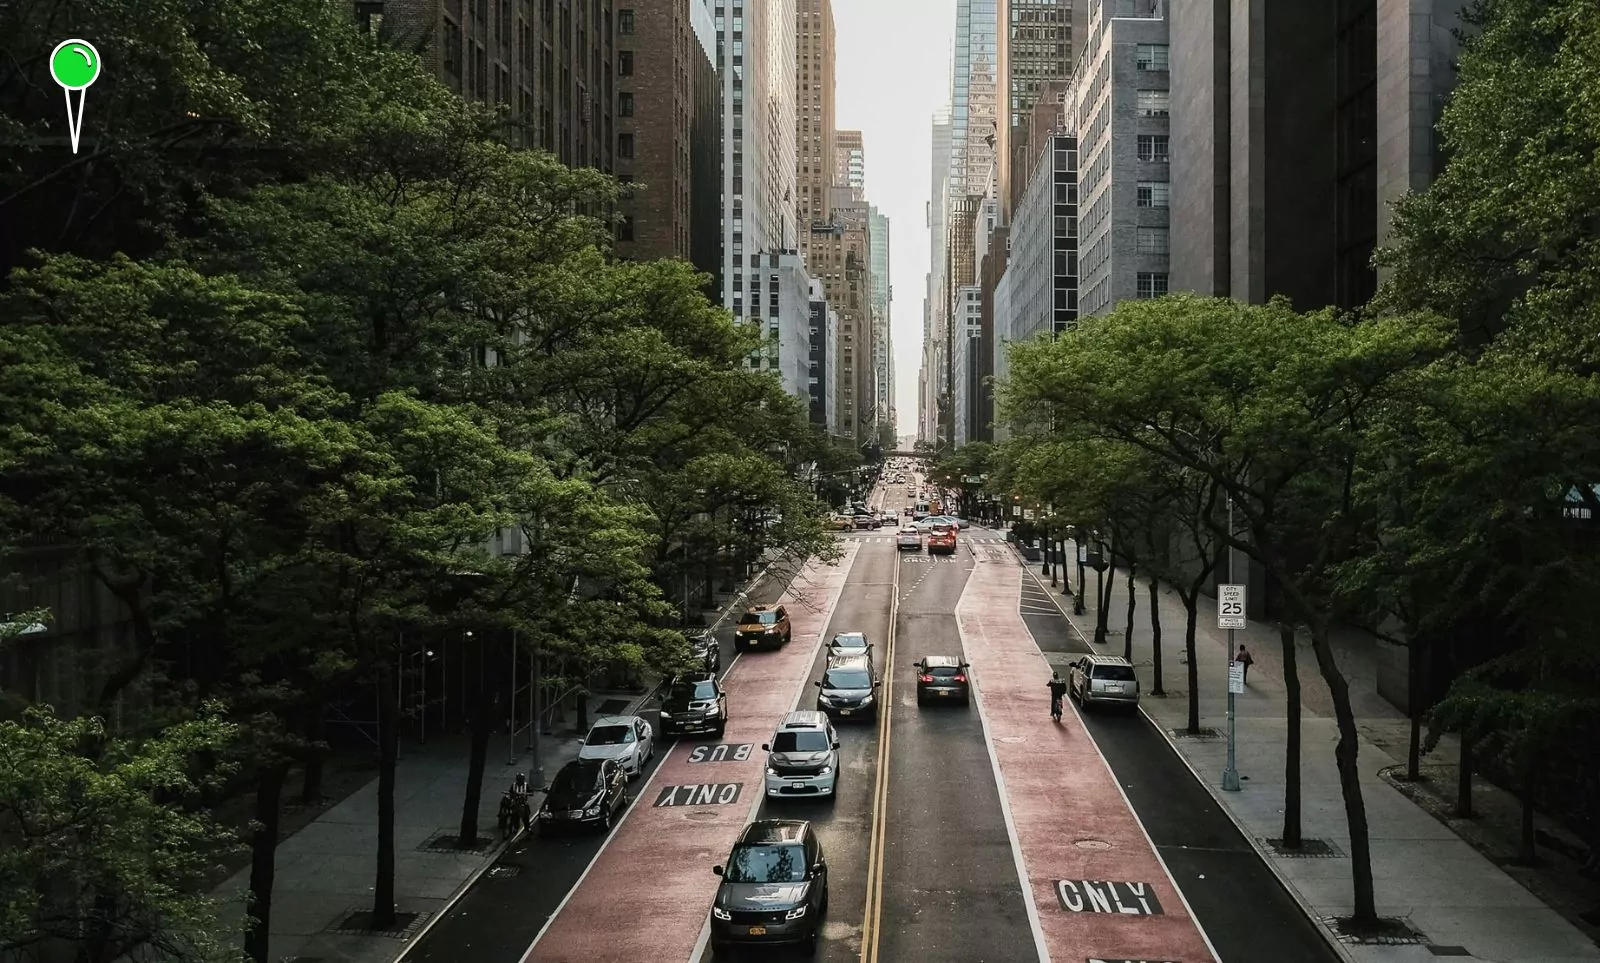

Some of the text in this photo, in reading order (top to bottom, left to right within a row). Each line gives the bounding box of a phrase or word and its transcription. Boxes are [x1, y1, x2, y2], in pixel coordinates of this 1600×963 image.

[1222, 602, 1242, 614] 25
[689, 744, 752, 762] BUS
[659, 783, 738, 807] ONLY
[1058, 879, 1153, 915] ONLY
